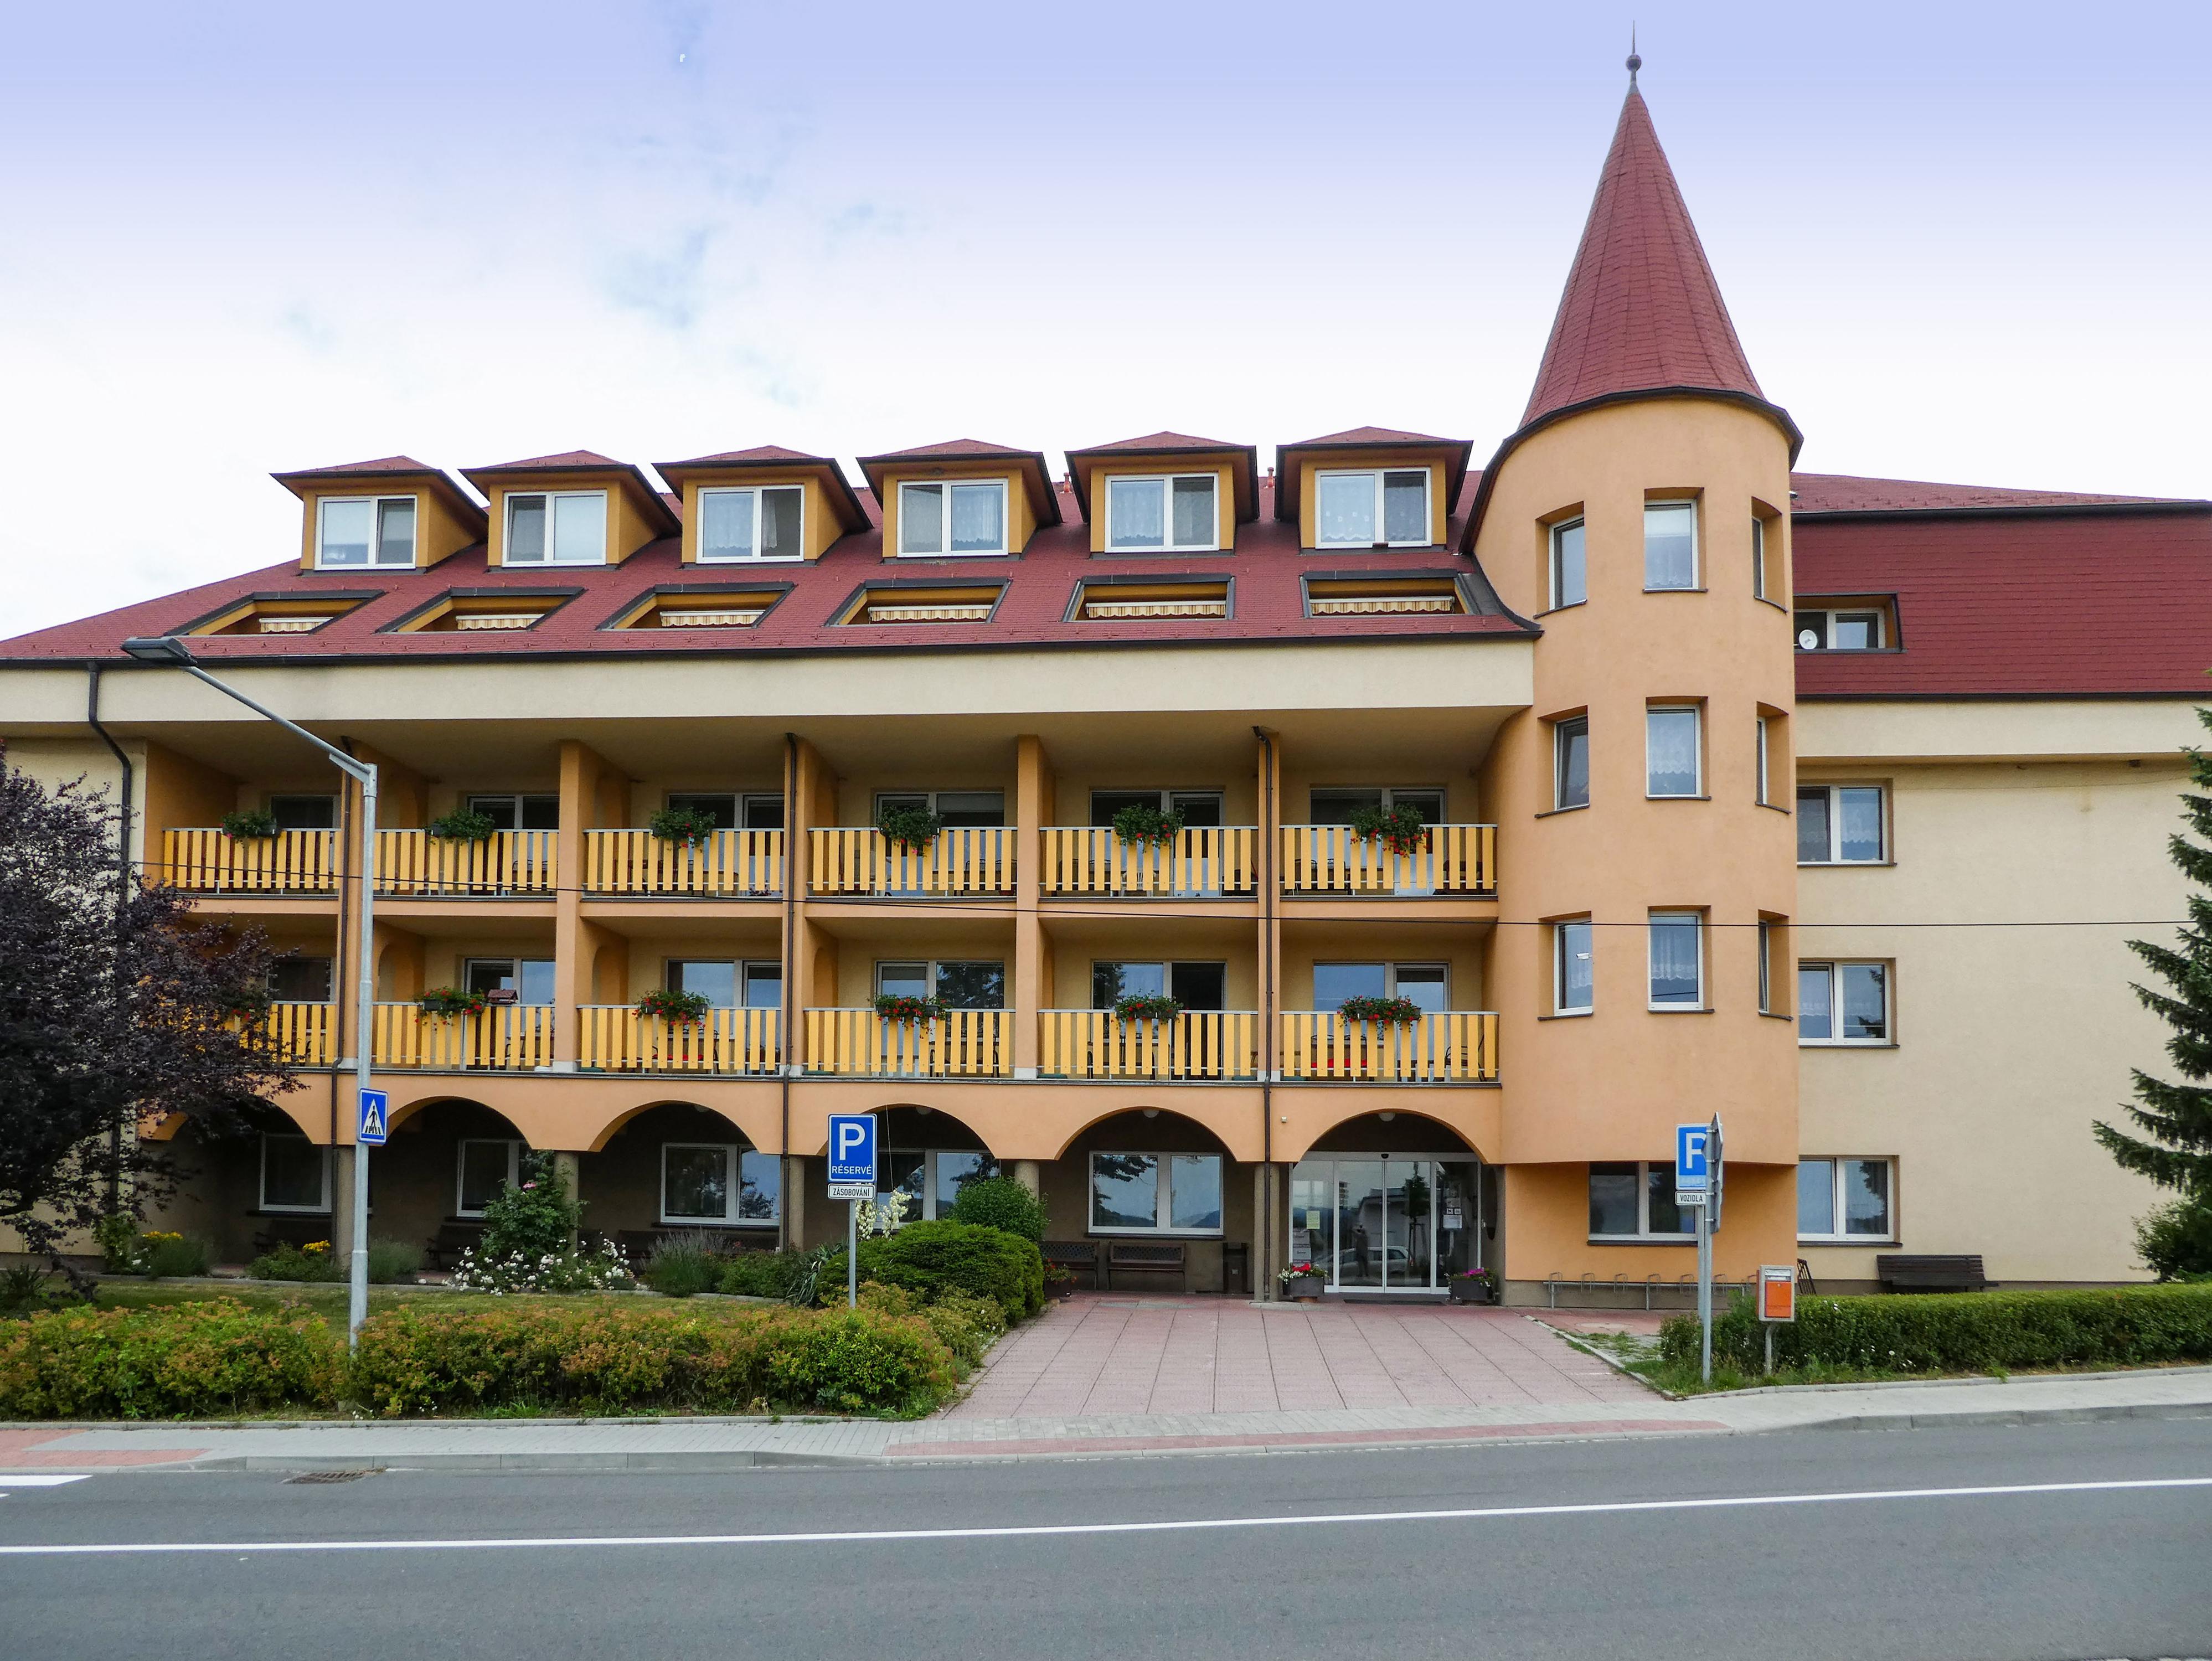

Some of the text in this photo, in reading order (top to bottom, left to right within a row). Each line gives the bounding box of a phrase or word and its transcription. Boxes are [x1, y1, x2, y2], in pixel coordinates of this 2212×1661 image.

[839, 1123, 865, 1160] P
[832, 1164, 872, 1174] RÉSERVÉ
[833, 1187, 870, 1196] ZÁSOBOVÁNÍ
